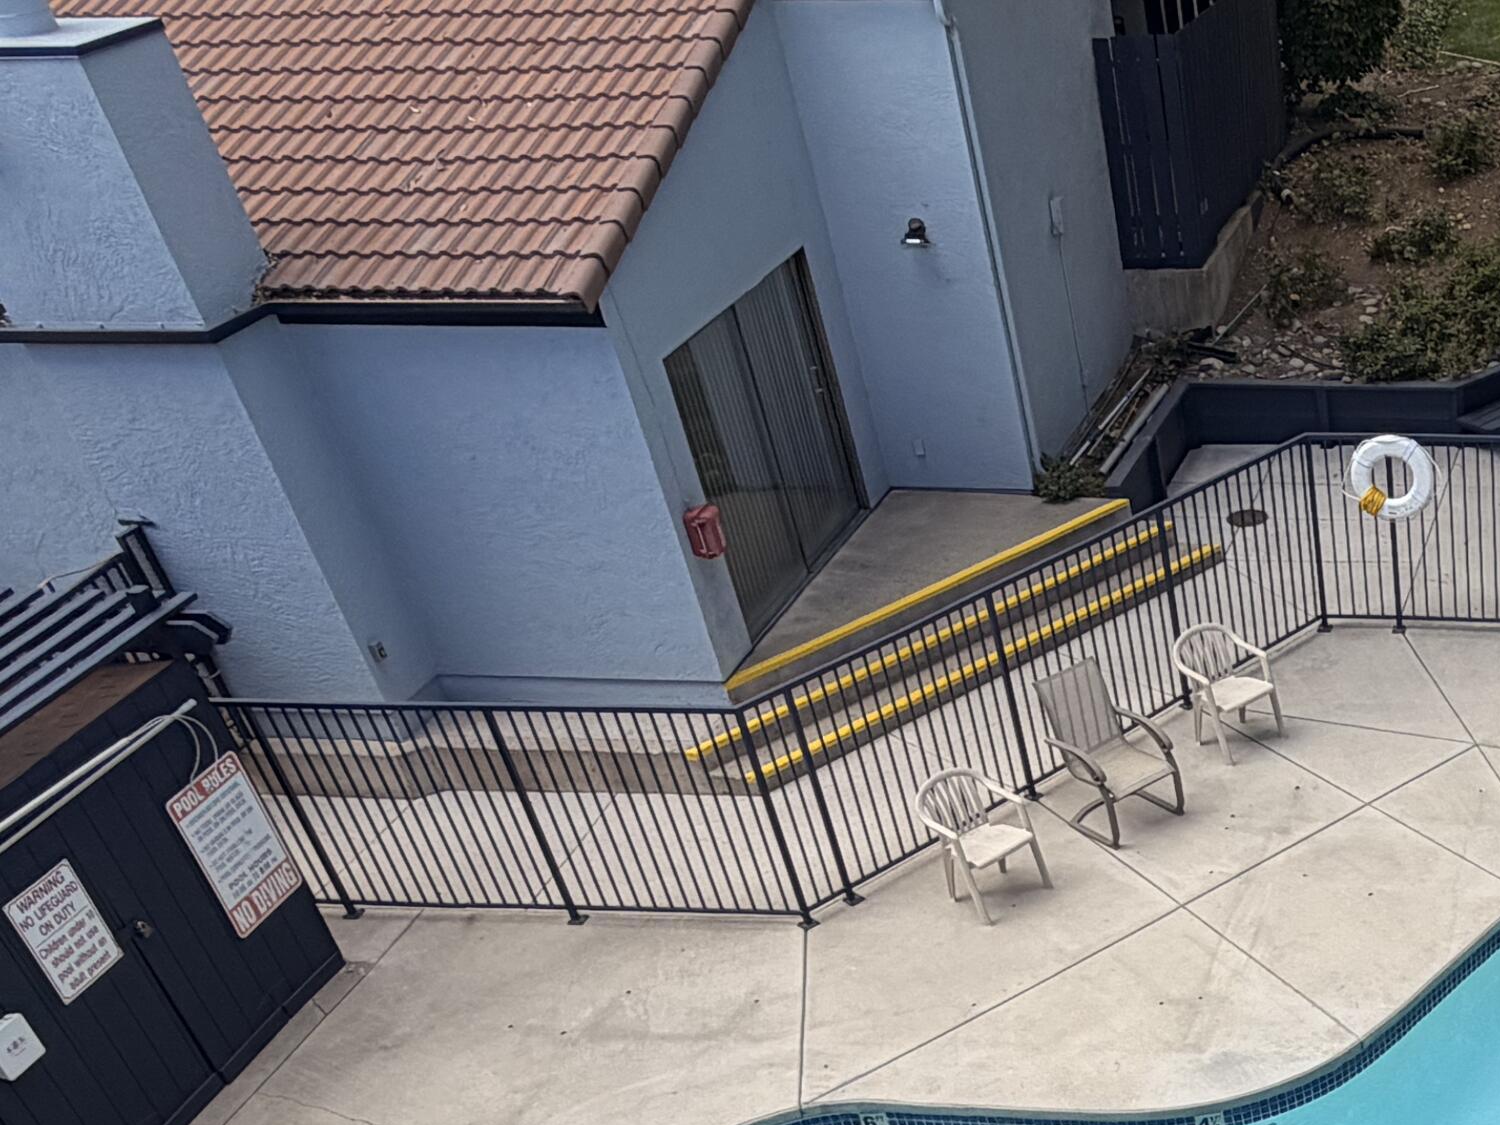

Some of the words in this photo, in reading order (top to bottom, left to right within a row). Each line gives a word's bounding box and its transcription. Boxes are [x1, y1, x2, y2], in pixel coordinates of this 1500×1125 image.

[172, 785, 206, 819] POOL
[16, 871, 66, 914] WARNING
[19, 915, 36, 933] NO
[33, 880, 79, 921] LIFEGUARD
[232, 900, 256, 932] NO
[251, 861, 295, 913] DIVING
[38, 919, 55, 937] ON
[53, 900, 77, 925] DUTY
